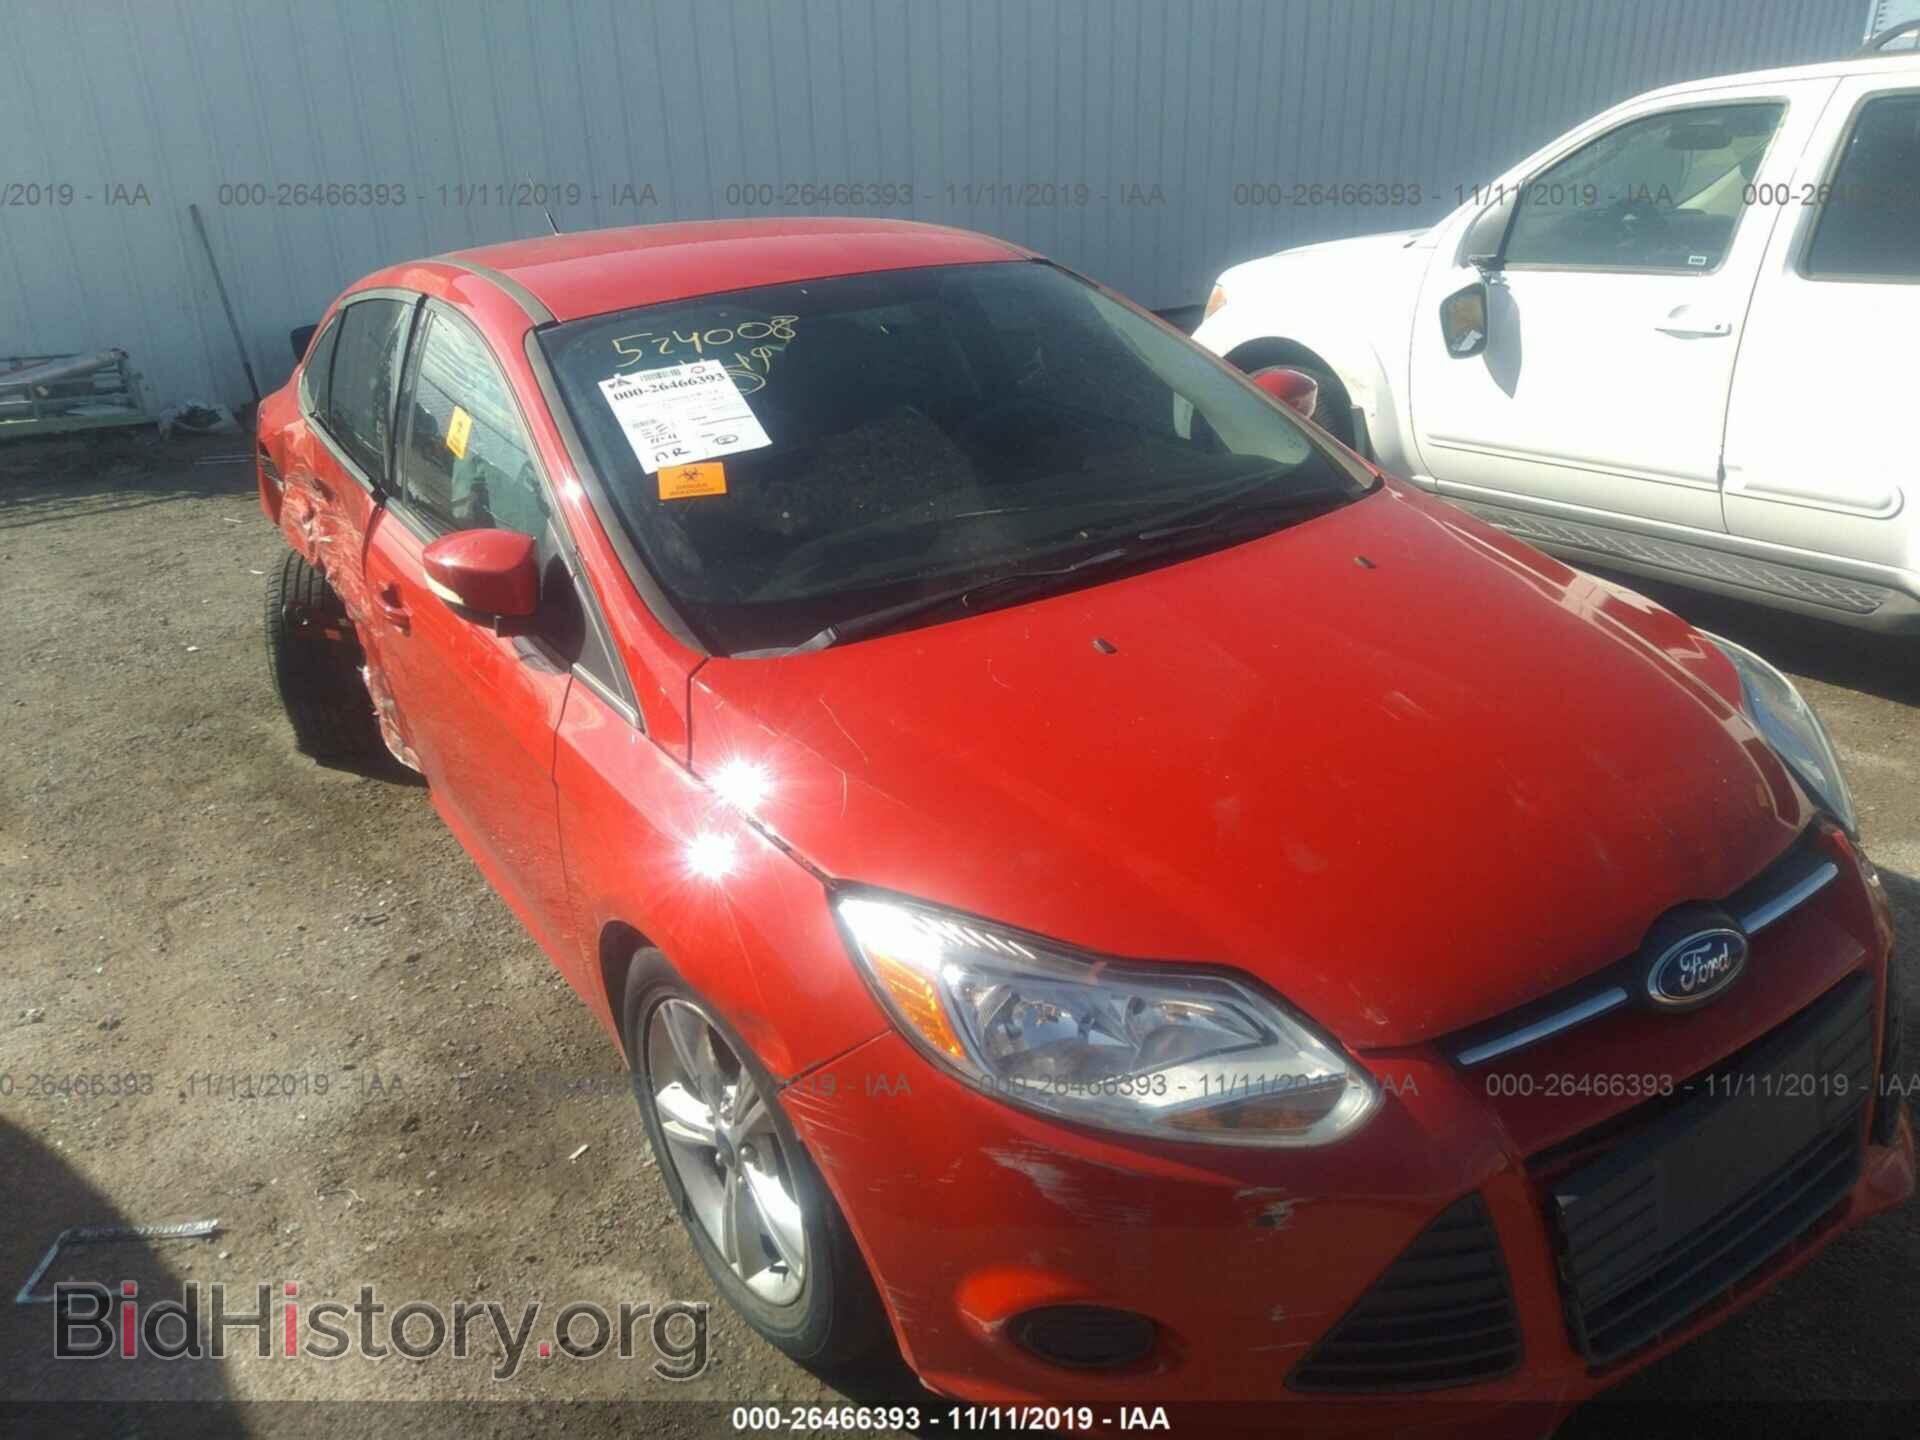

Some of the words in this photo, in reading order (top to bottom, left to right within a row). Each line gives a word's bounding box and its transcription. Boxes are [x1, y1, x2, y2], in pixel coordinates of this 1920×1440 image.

[612, 315, 800, 368] 524008
[613, 372, 725, 402] 000-26466393
[1679, 942, 1729, 992] Ford
